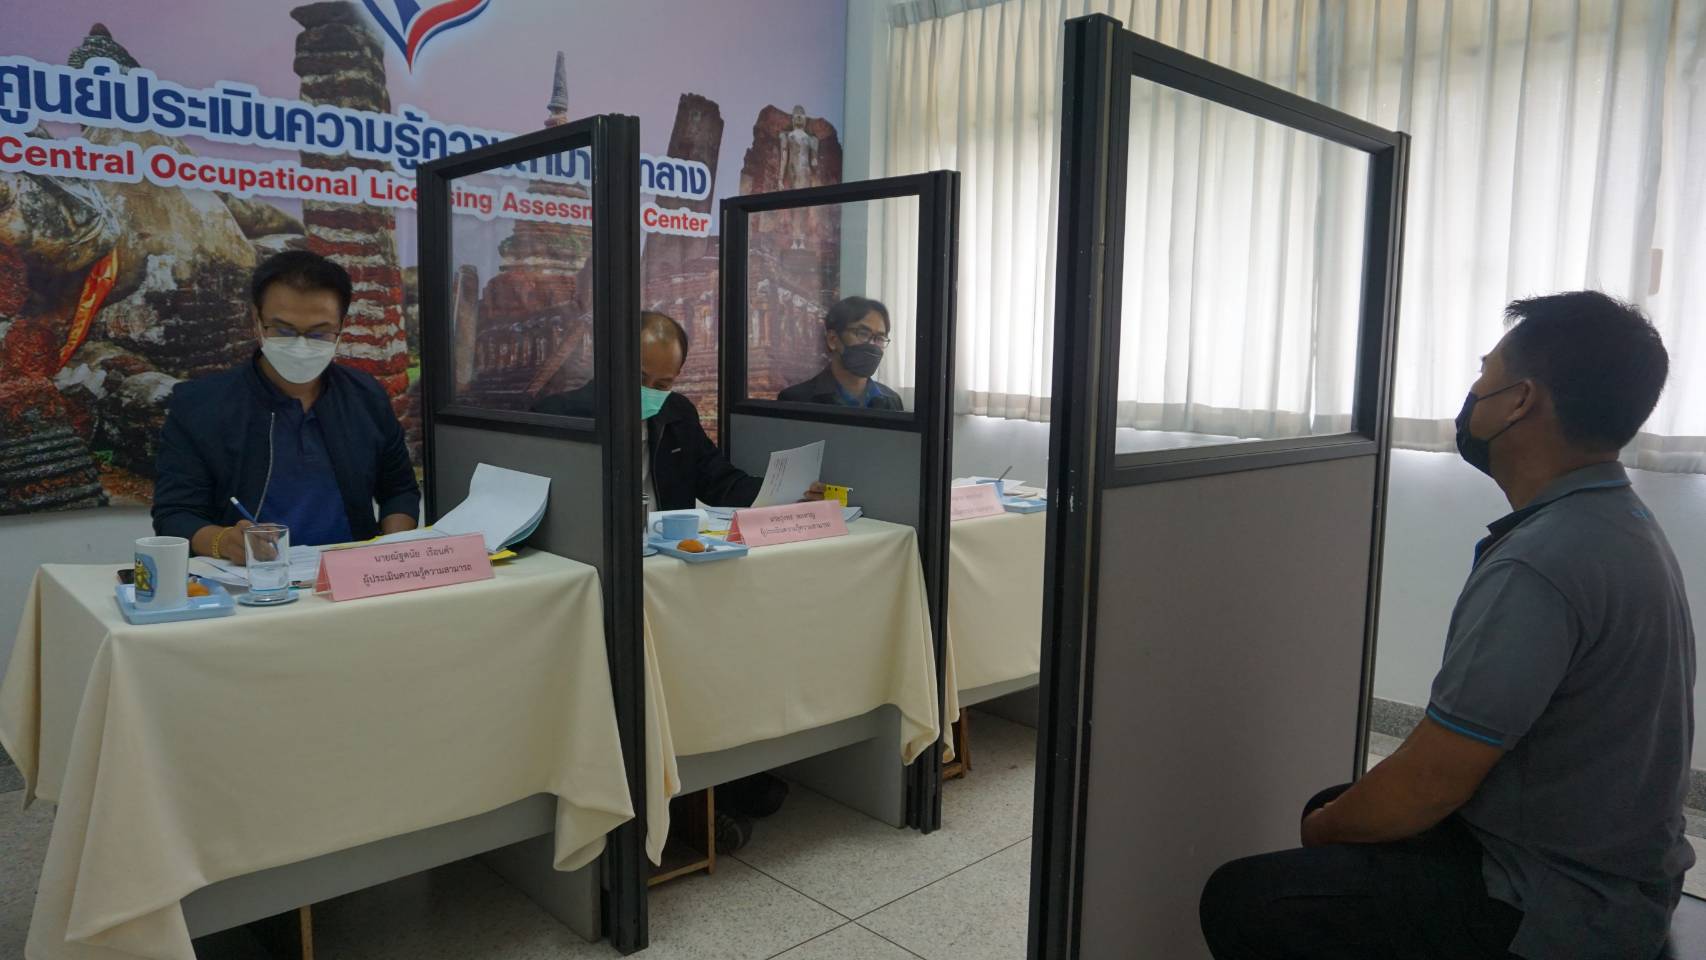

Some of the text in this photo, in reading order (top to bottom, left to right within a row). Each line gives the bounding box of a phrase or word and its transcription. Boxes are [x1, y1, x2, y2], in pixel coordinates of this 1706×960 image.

[0, 136, 710, 232] Central Occupational Licing Assess Center
